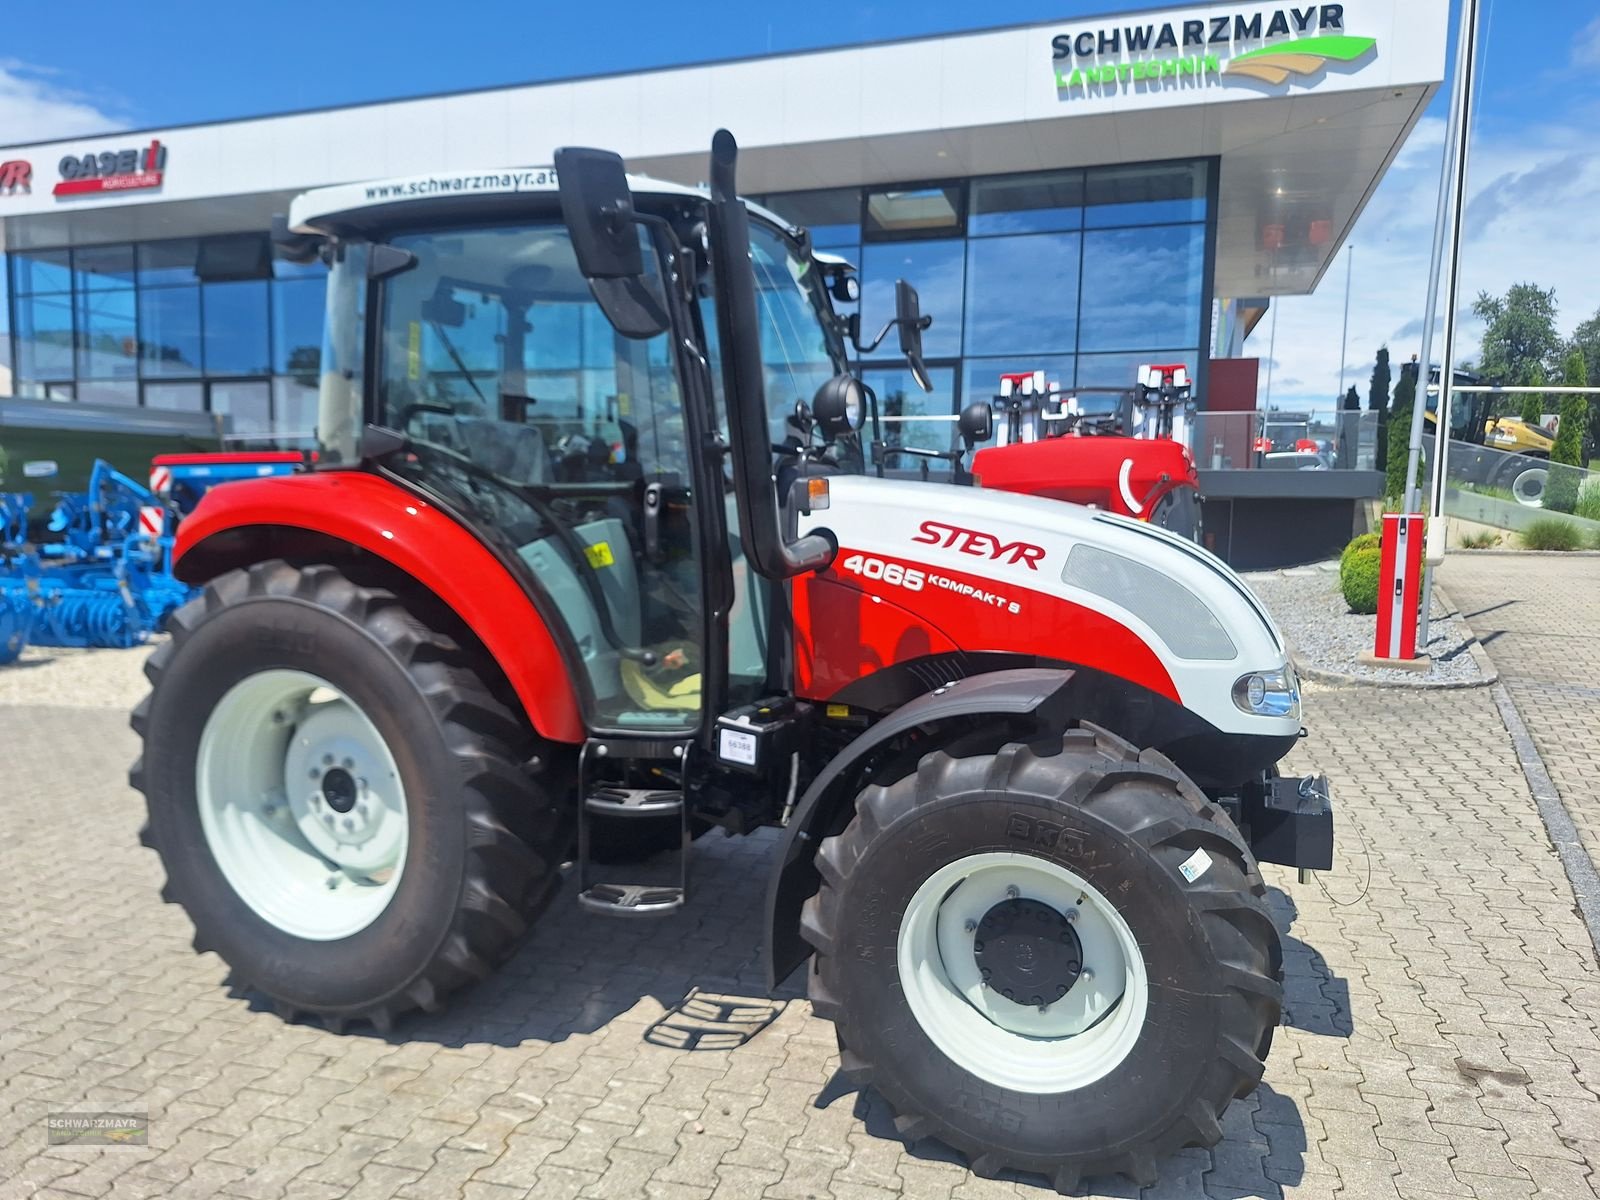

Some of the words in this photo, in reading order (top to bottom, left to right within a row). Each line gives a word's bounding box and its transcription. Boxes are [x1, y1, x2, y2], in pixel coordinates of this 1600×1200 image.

[1051, 4, 1343, 59] SCHWARZMAYR
[1055, 53, 1220, 88] LANDTECHNIK
[58, 149, 138, 179] CASE
[365, 170, 556, 199] www.schwarzmayr.at
[911, 520, 1046, 571] STEYR
[843, 554, 926, 592] 4065
[927, 573, 1007, 608] KOMPAKT
